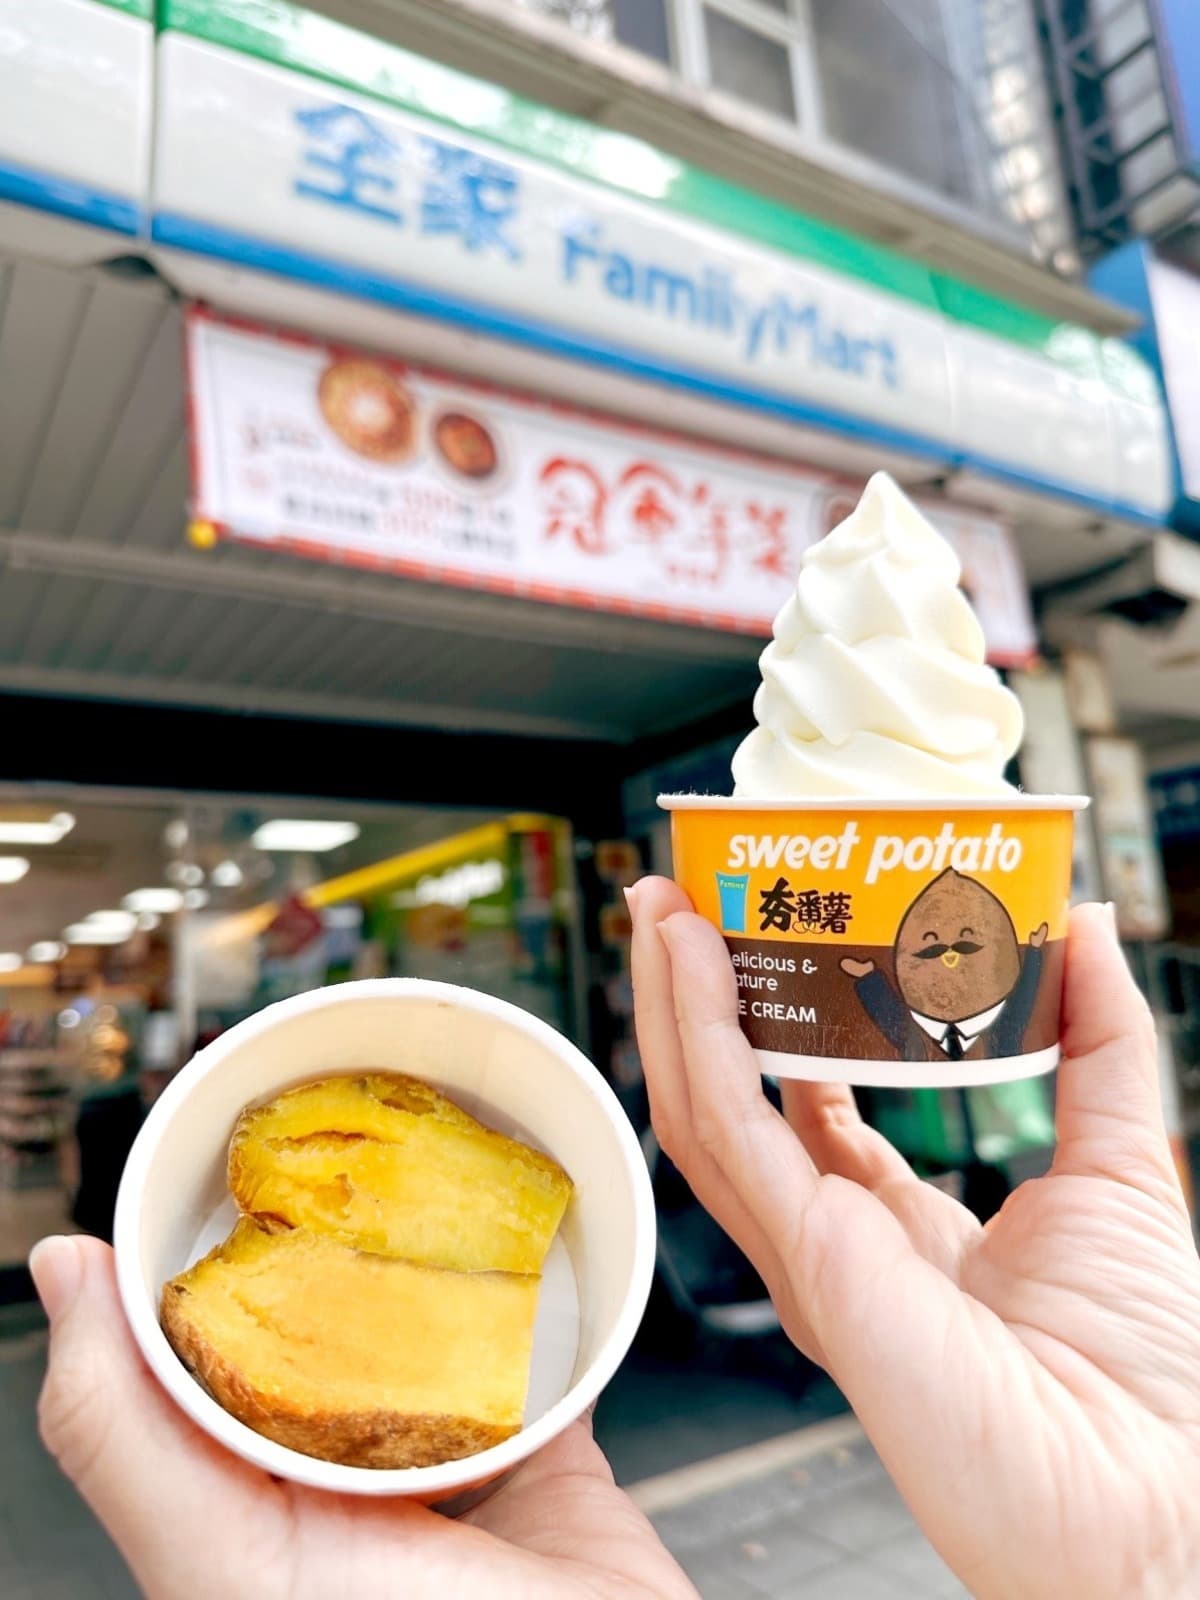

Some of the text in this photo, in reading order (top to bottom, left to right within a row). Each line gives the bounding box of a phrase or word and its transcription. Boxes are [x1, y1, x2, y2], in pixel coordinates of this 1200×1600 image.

[294, 105, 524, 261] 全家
[560, 220, 900, 389] FamilyMart
[727, 821, 1022, 885] sweet potato
[758, 876, 853, 934] 夯番薯
[731, 951, 818, 975] elicious &
[735, 972, 778, 991] ature
[751, 1001, 817, 1024] CREAM
